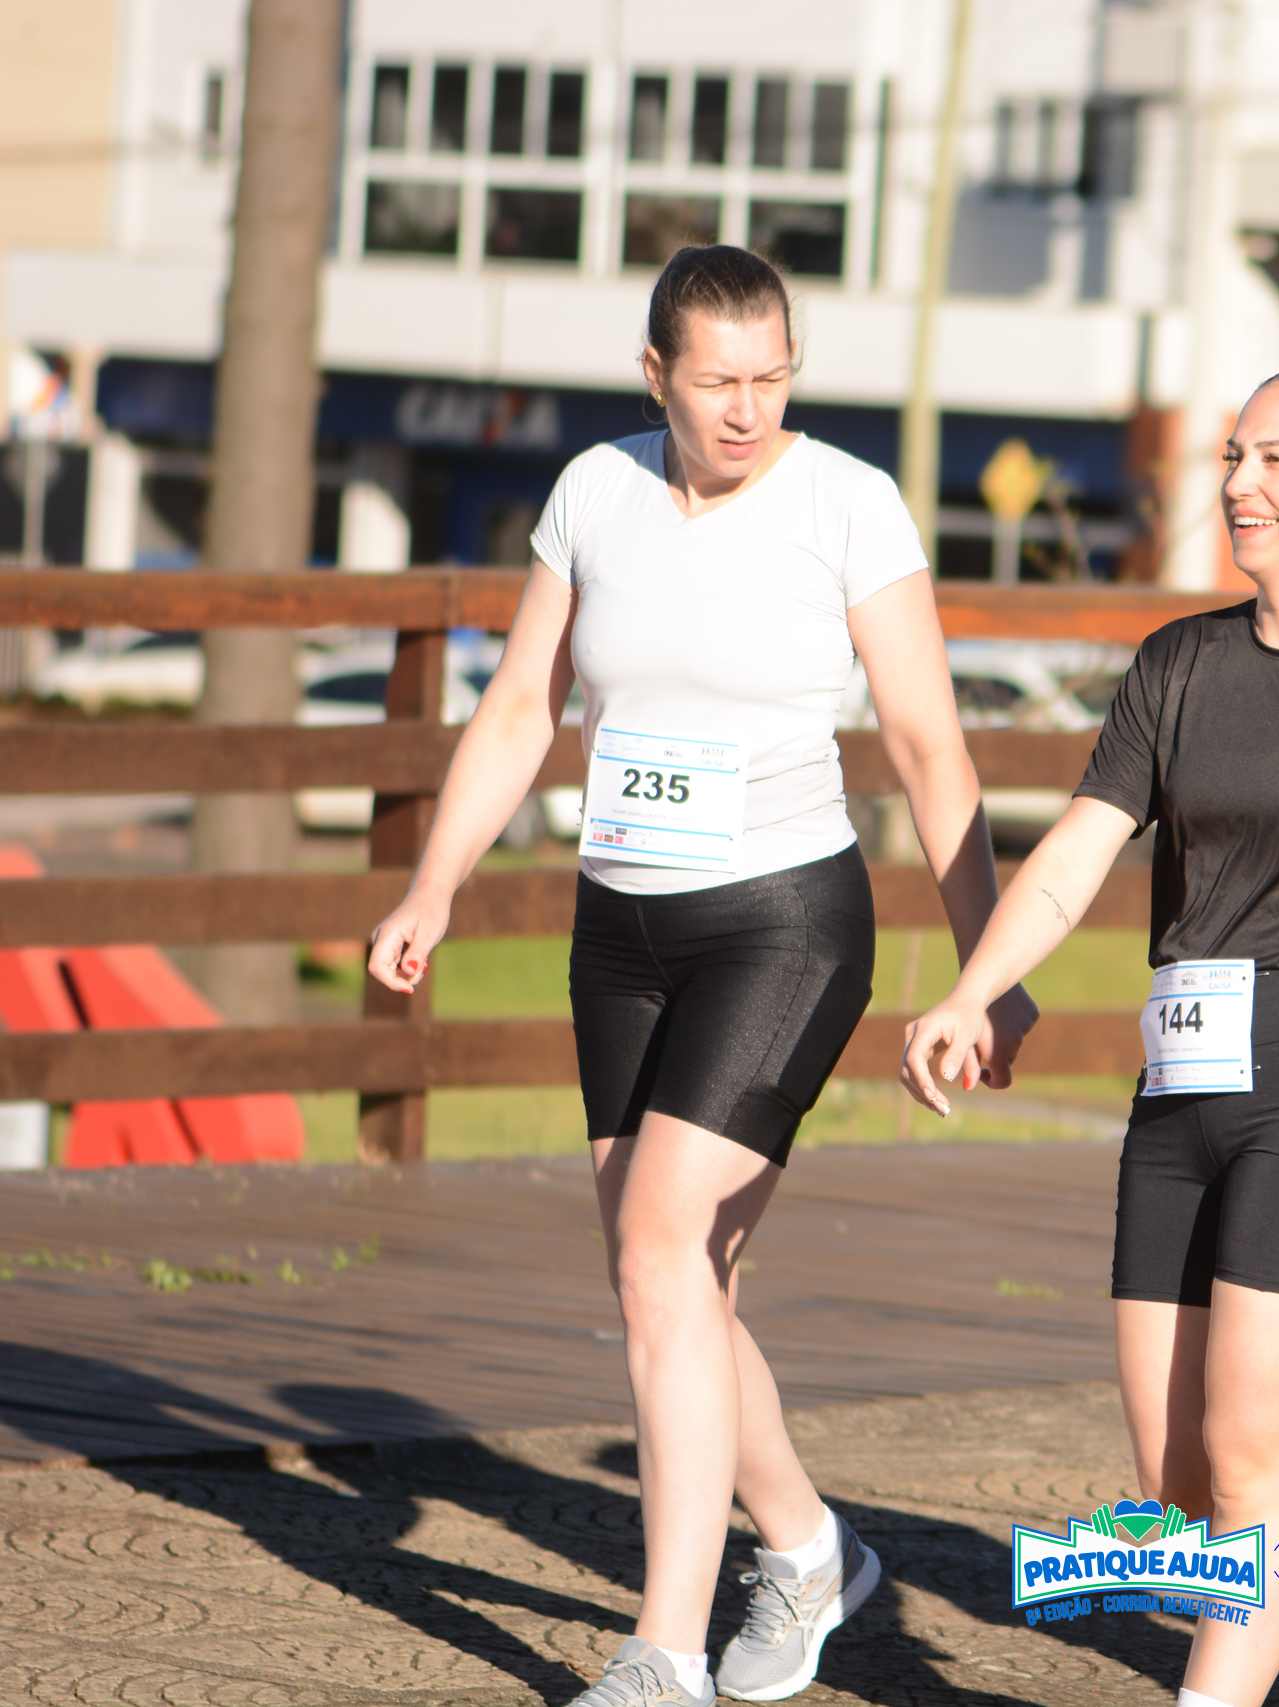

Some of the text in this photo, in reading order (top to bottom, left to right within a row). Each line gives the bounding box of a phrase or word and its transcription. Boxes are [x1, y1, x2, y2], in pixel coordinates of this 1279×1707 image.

[700, 759, 724, 767] CAUSA
[621, 768, 690, 804] 235
[1209, 982, 1231, 990] CAUSA
[1159, 1002, 1203, 1035] 144
